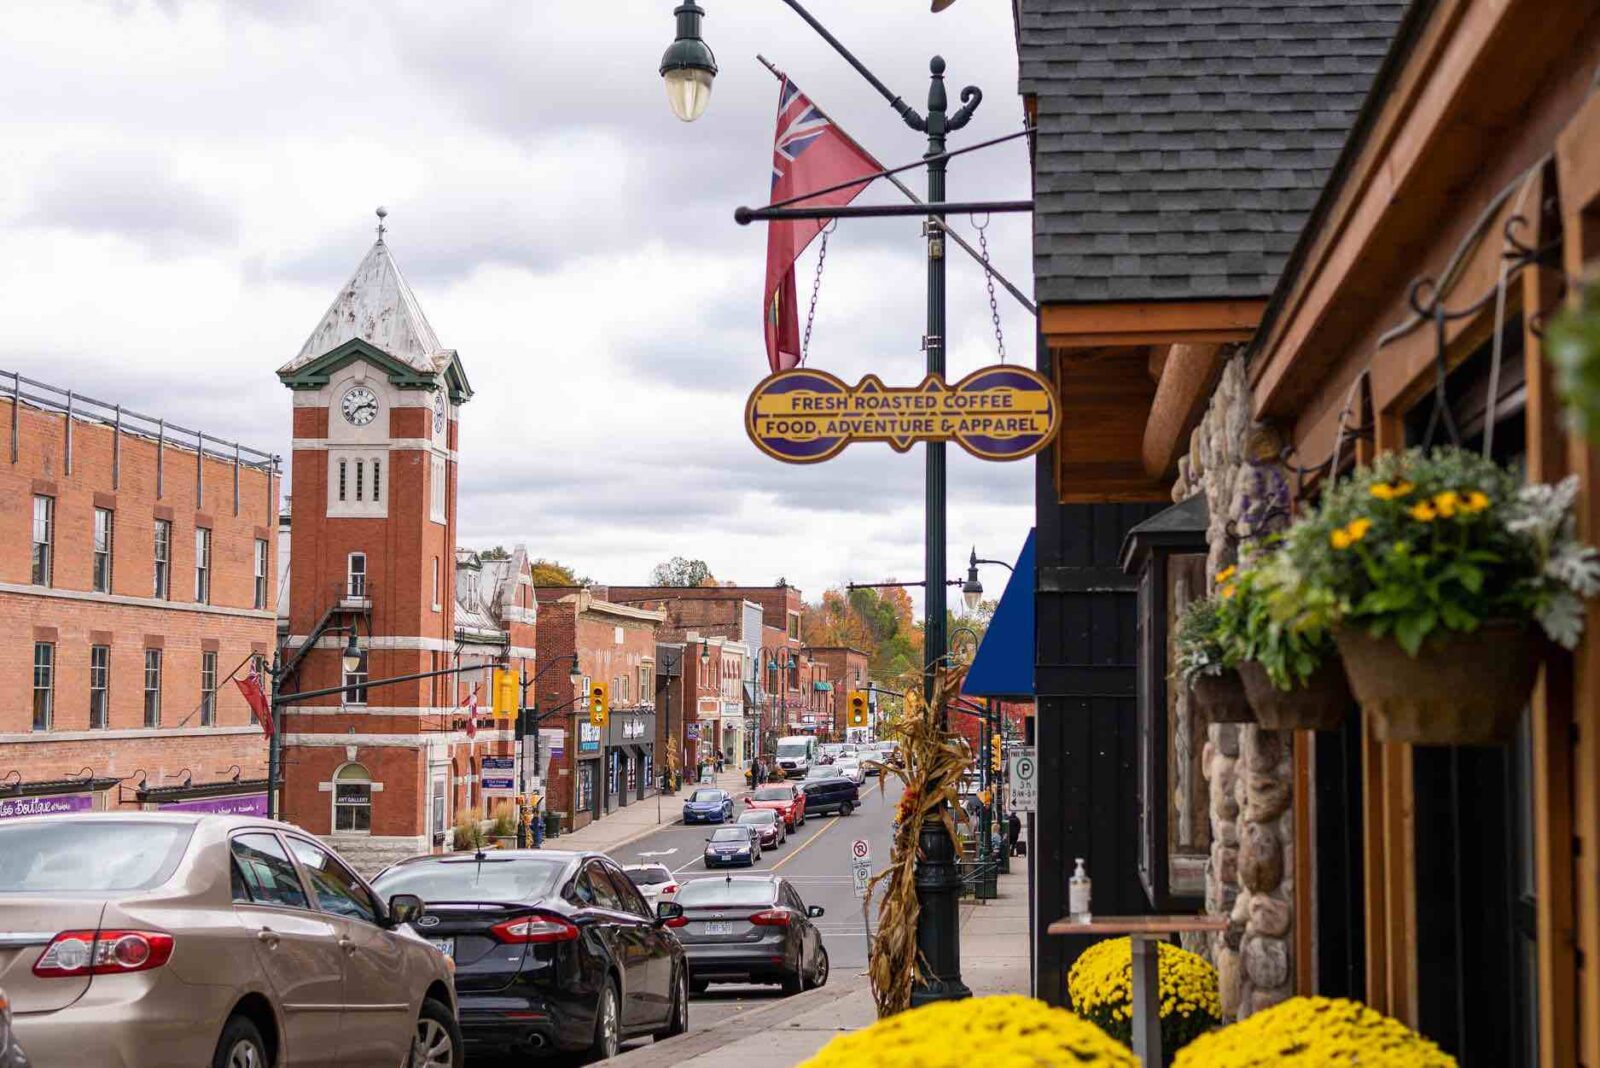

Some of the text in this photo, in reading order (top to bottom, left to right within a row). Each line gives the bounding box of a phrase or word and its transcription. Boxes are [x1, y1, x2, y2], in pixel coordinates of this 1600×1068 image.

[791, 394, 1014, 411] FRESH ROASTED COFFEE
[765, 417, 1040, 436] FOOD, ADVENTURE & APPAREL
